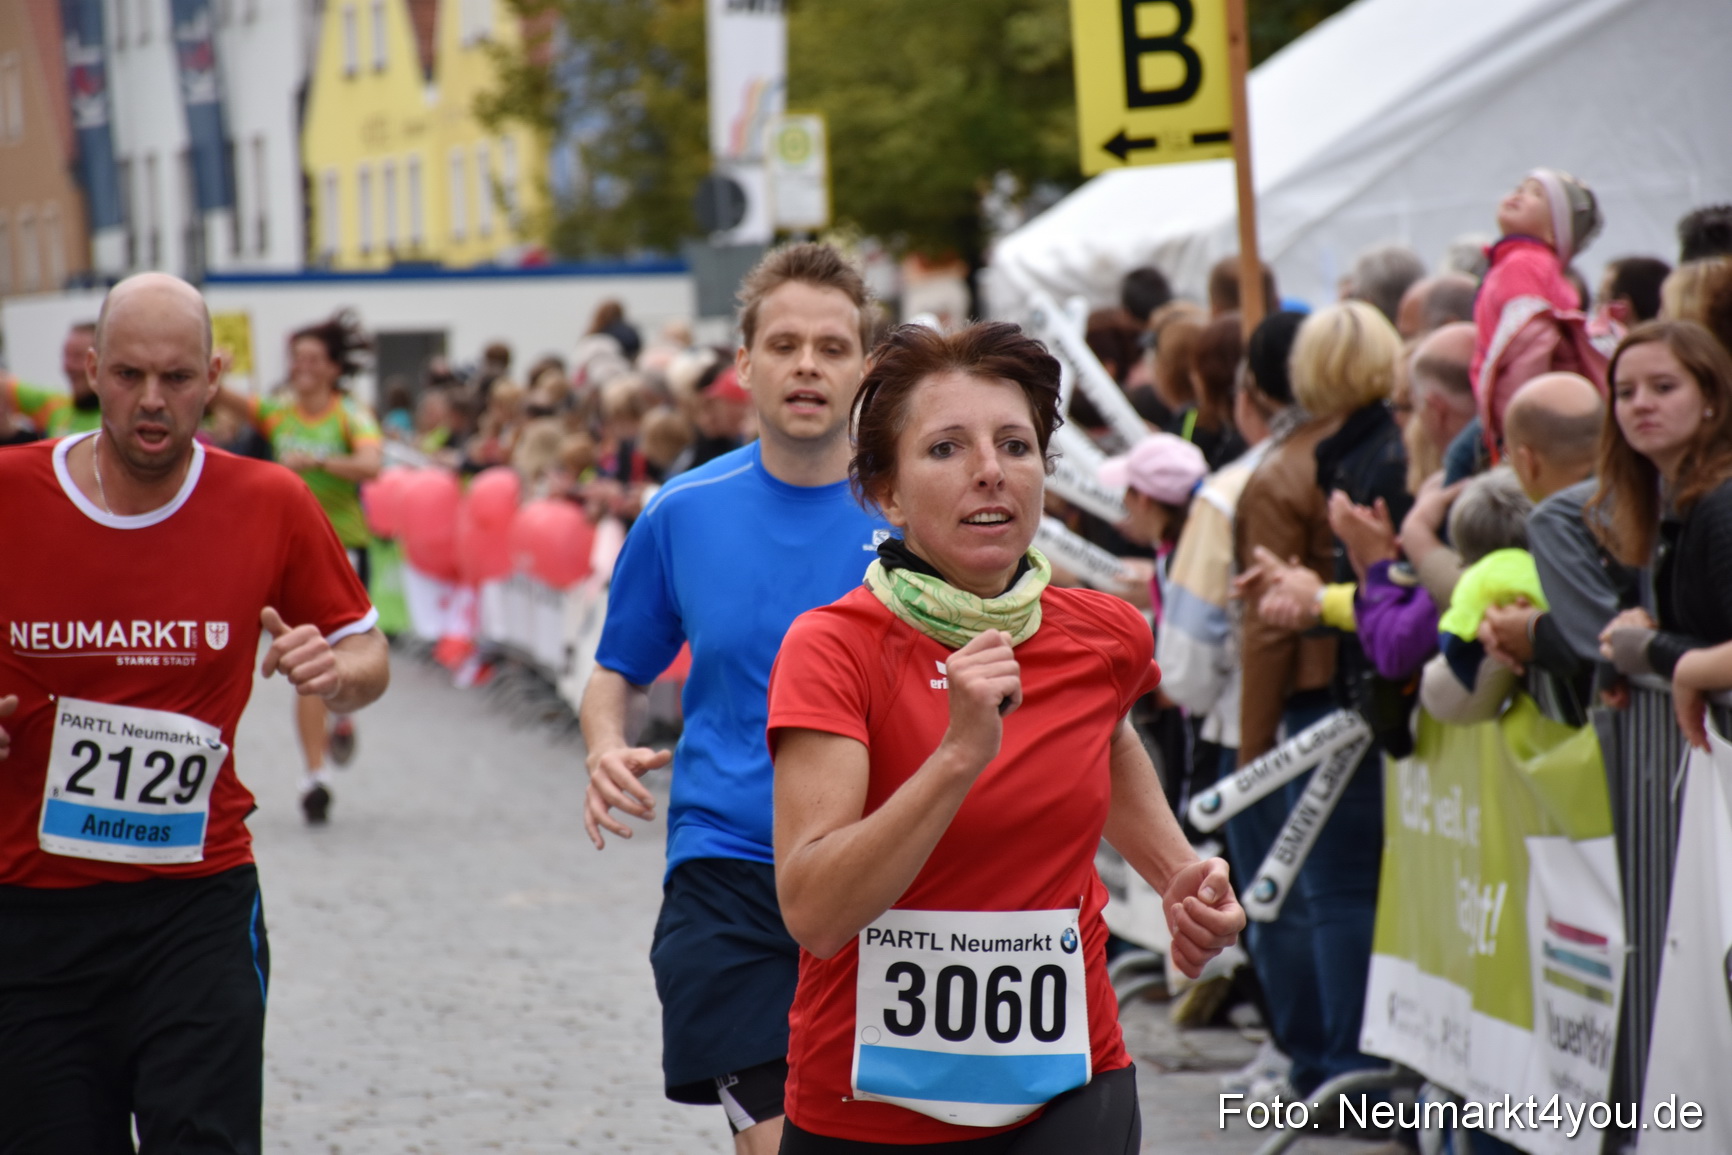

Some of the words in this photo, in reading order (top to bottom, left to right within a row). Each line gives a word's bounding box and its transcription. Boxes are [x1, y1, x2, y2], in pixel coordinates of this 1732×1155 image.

[1120, 0, 1204, 109] B
[10, 620, 197, 649] NEUMARKT
[116, 656, 159, 666] STARKE
[162, 656, 196, 666] STADT
[930, 678, 948, 689] eri
[60, 712, 117, 735] PARTL
[121, 723, 202, 746] Neumarkt
[65, 739, 208, 805] 2129
[80, 813, 172, 842] Andreas
[1275, 805, 1318, 866] BMW
[866, 928, 944, 951] PARTL
[950, 933, 1052, 952] Neumarkt
[883, 961, 1067, 1044] 3060
